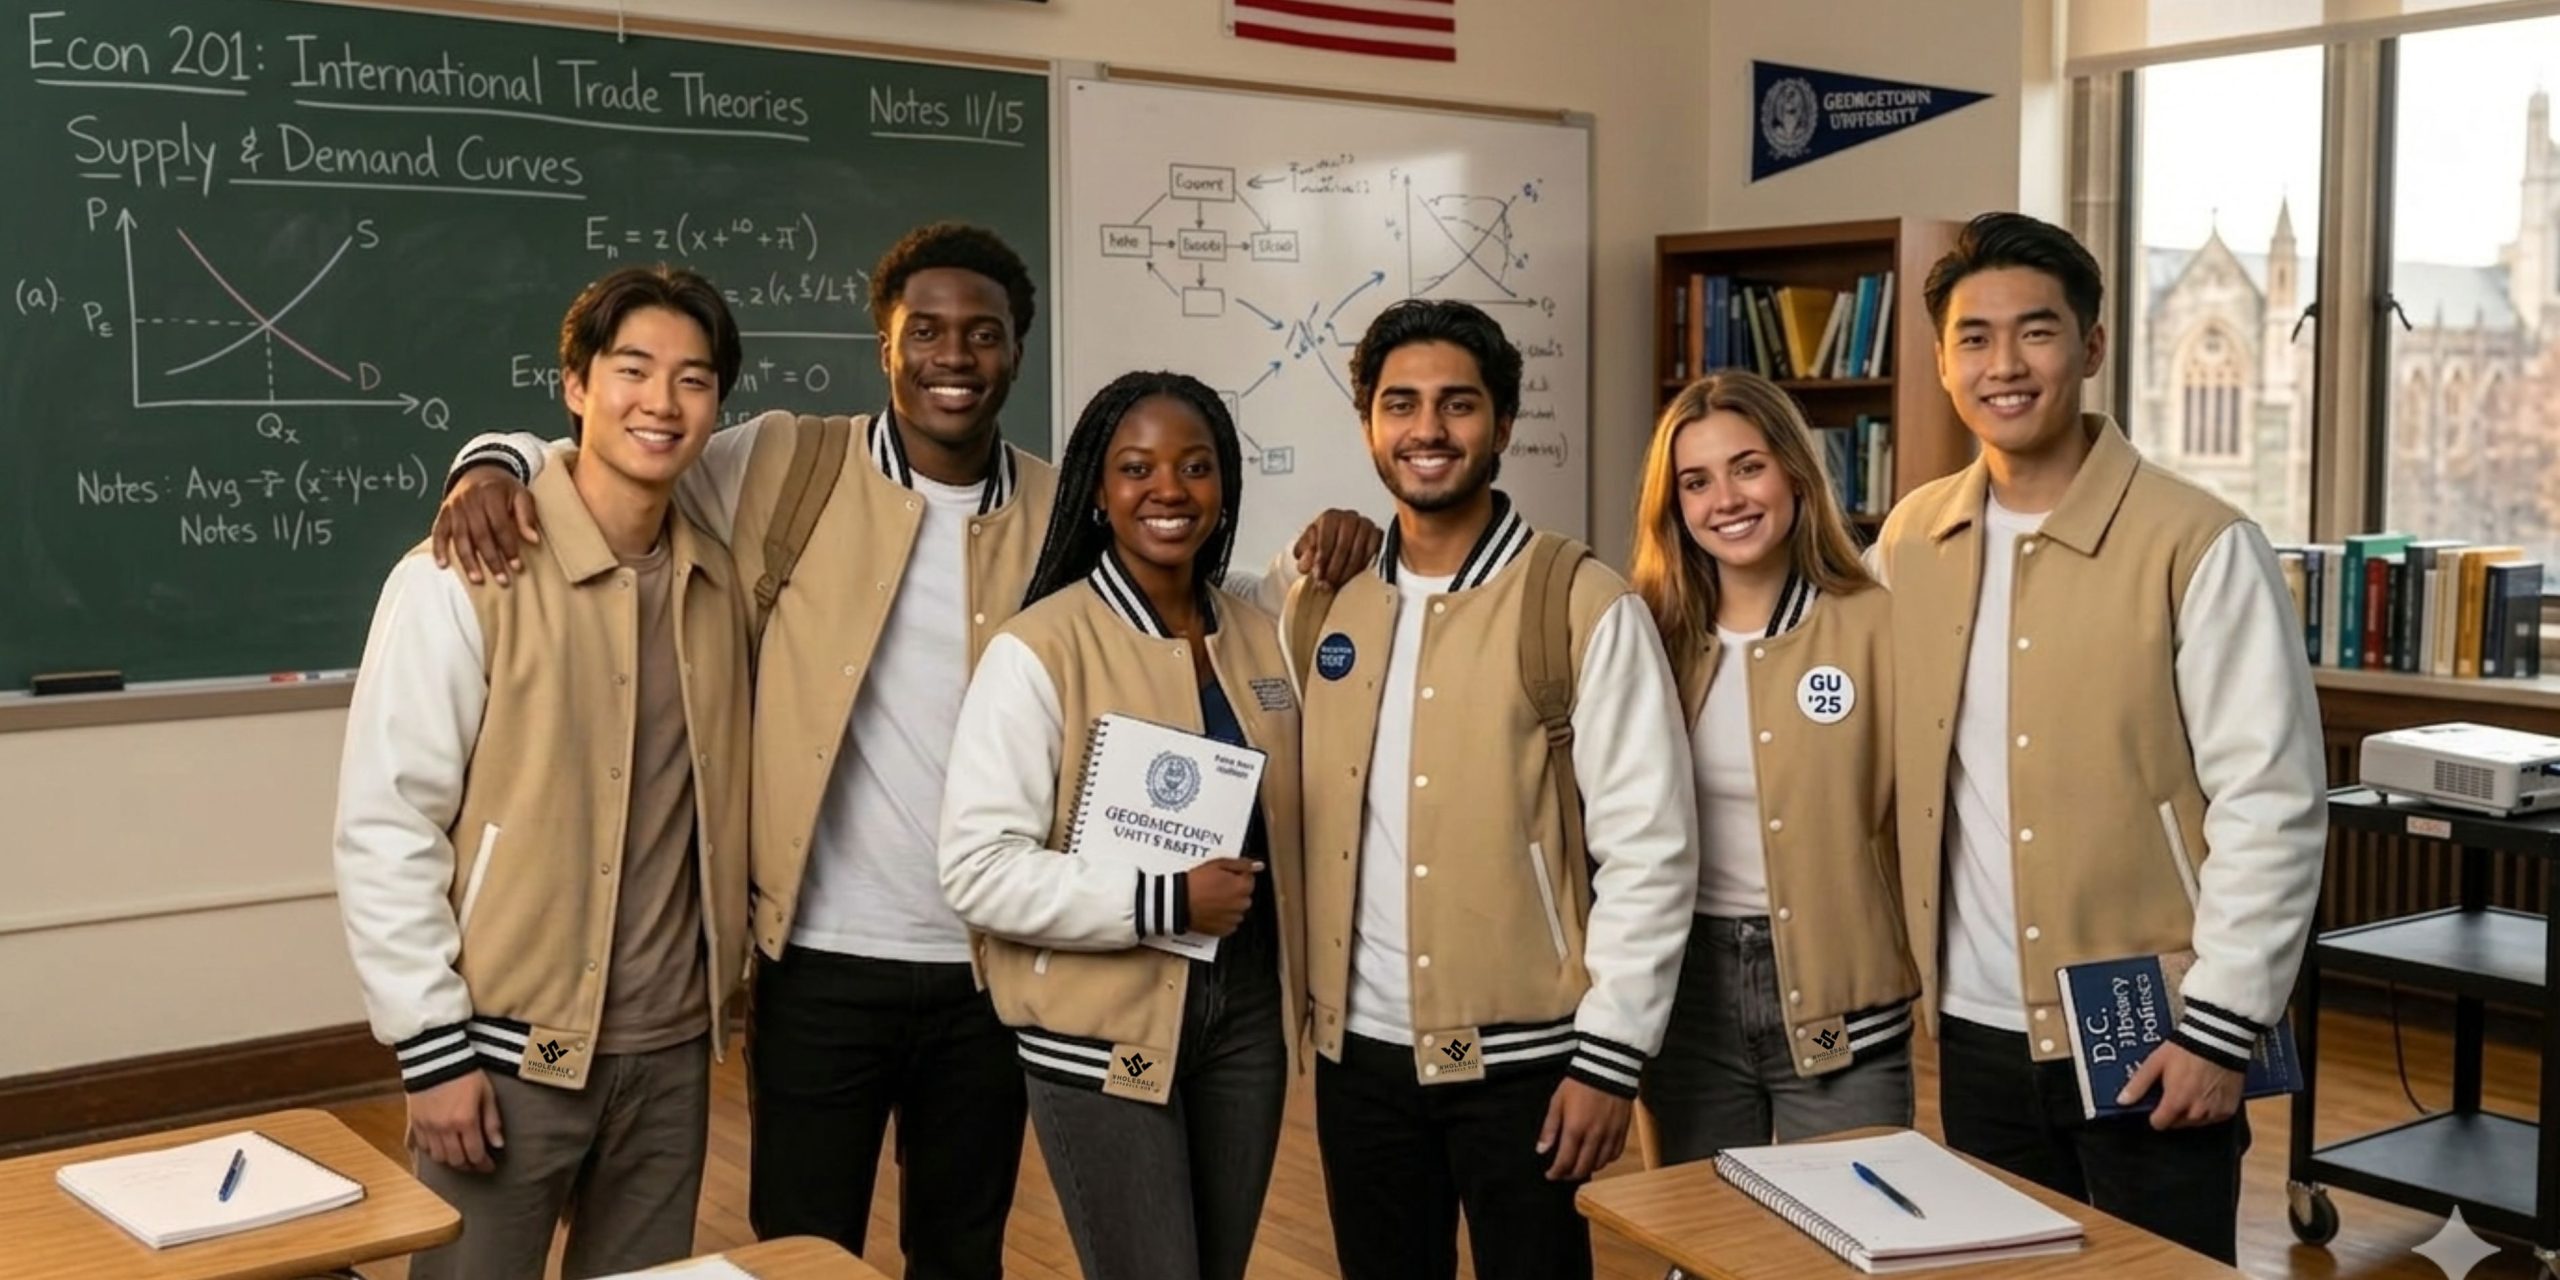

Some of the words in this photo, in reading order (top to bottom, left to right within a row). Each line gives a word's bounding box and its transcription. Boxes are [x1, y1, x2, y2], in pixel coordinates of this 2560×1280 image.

[28, 11, 150, 76] Econ
[169, 25, 266, 82] 201:
[285, 33, 544, 106] International
[556, 60, 664, 114] Trade
[669, 71, 809, 126] Theories
[869, 84, 950, 127] Notes
[965, 90, 1025, 140] 11/15
[66, 114, 216, 198] Supply
[240, 127, 264, 173] &
[276, 122, 439, 180] Demand
[456, 135, 585, 187] Curves
[86, 198, 108, 231] P
[357, 219, 380, 249] S
[358, 362, 381, 391] D
[421, 397, 449, 431] Q
[186, 467, 242, 507] Avg
[181, 514, 258, 546] Notes
[272, 510, 334, 551] 11/15
[1809, 674, 1842, 692] GU
[1808, 695, 1842, 715] '25
[2086, 1007, 2117, 1064] D.C.
